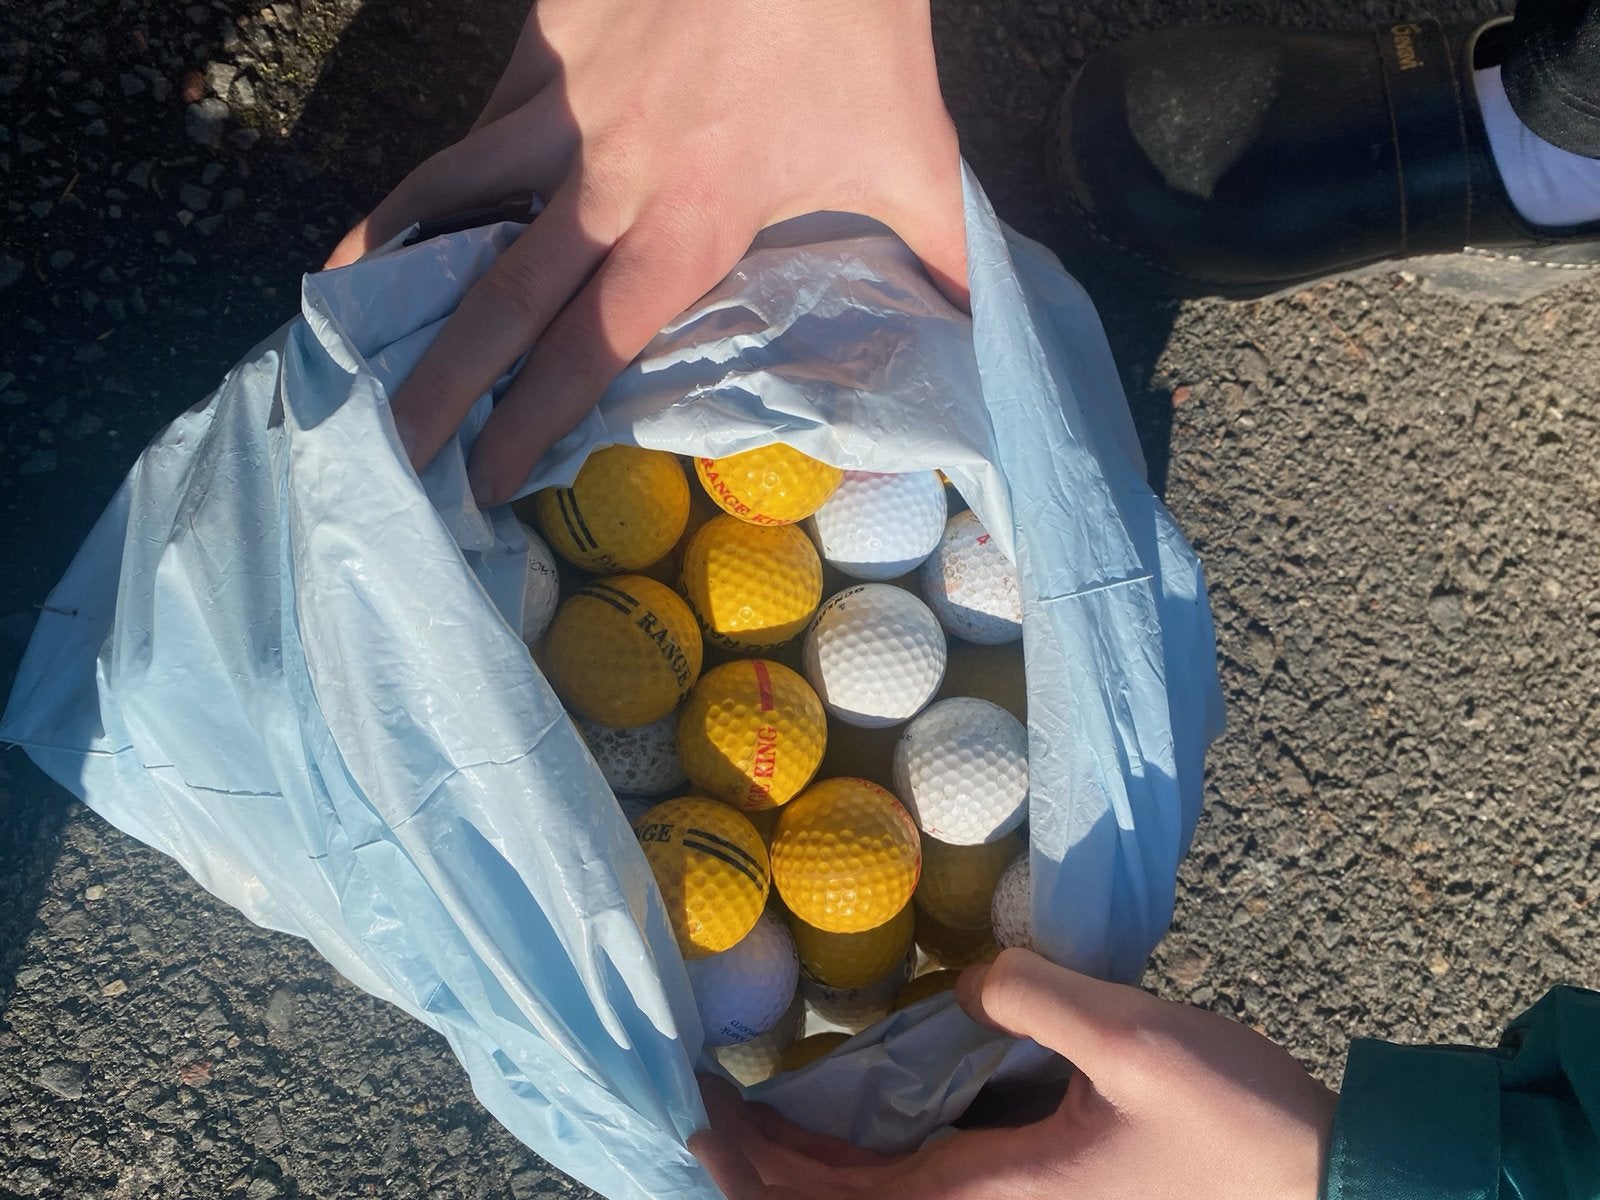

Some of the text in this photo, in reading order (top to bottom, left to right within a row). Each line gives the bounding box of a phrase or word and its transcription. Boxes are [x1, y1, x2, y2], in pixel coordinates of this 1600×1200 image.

[701, 457, 751, 515] RANGE
[636, 610, 692, 688] RANGE
[753, 725, 777, 779] KING
